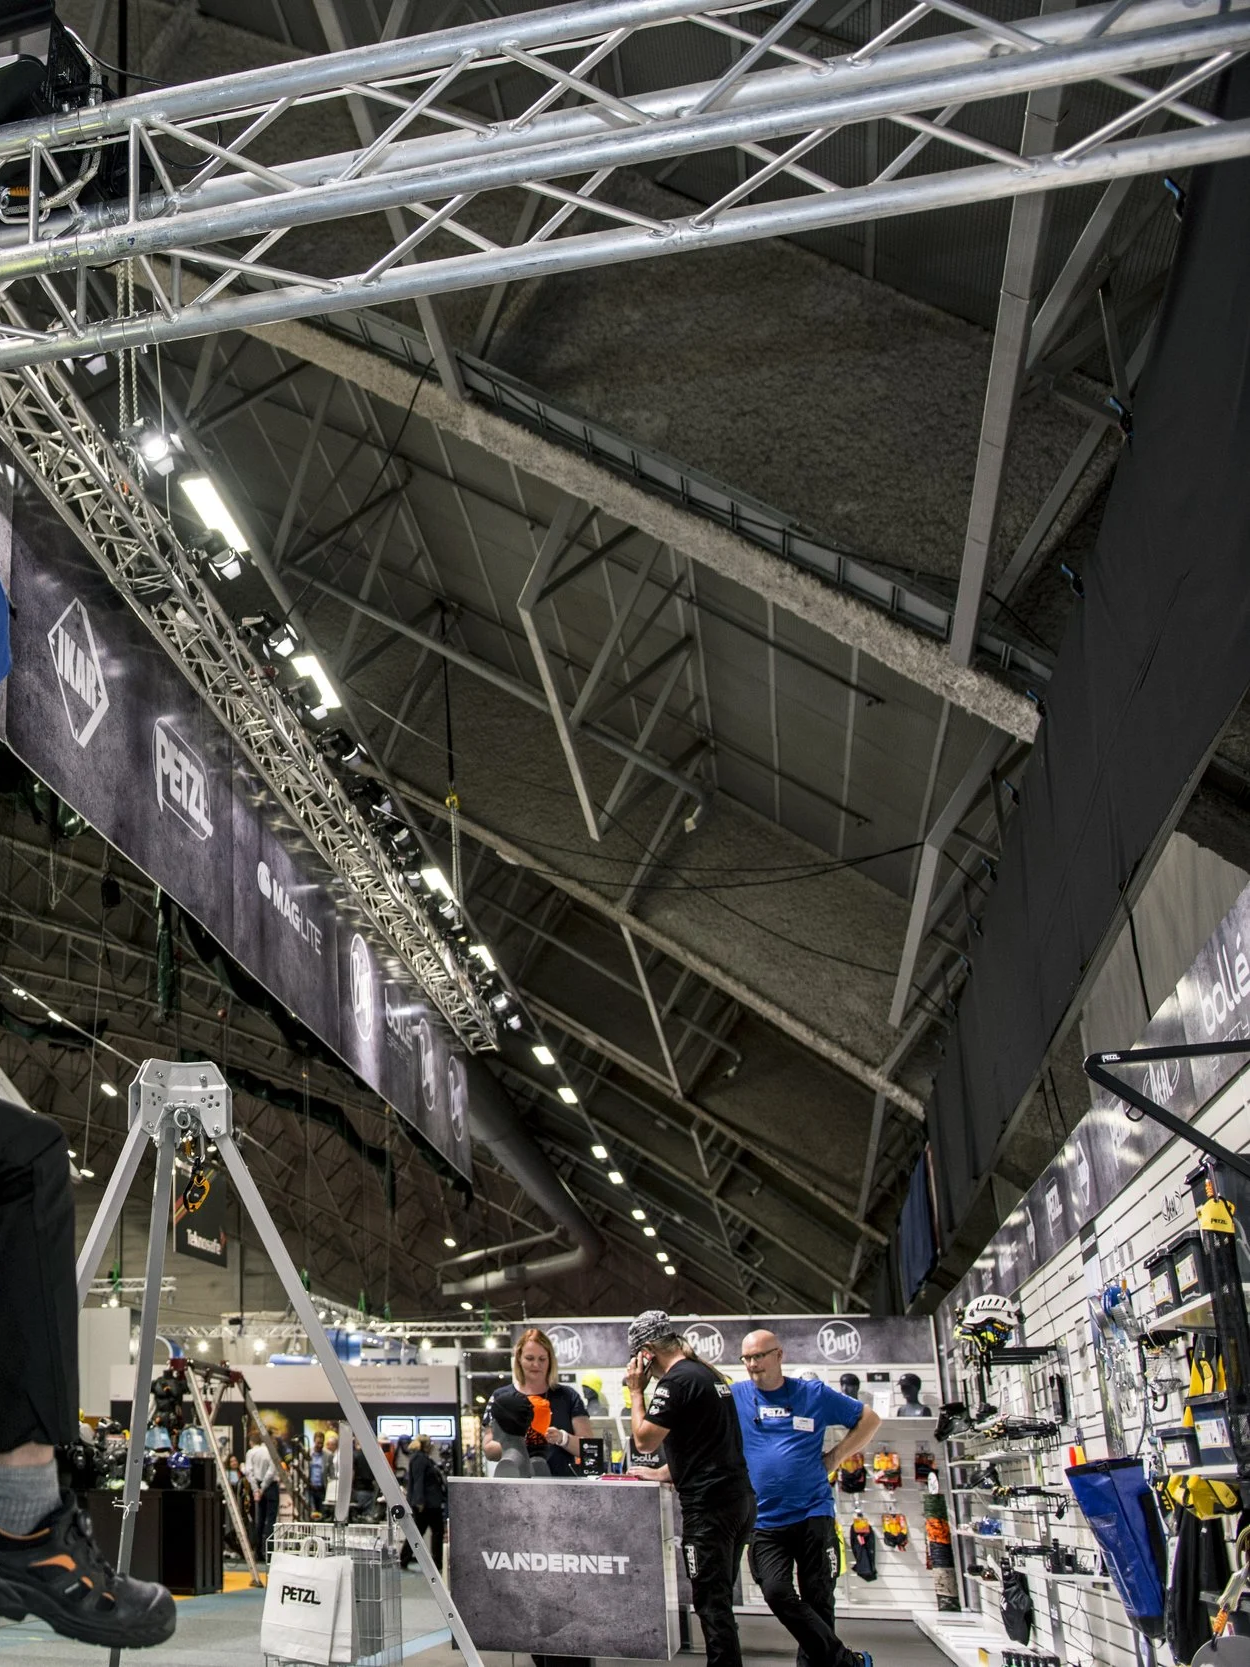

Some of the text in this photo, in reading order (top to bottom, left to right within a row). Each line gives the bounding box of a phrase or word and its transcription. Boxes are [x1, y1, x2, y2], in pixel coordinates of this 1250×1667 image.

[57, 623, 98, 713] IKAR
[155, 722, 215, 838] PETZL
[1196, 931, 1250, 1036] bollé
[281, 1584, 322, 1606] PETZL
[481, 1551, 630, 1575] VANDERNET
